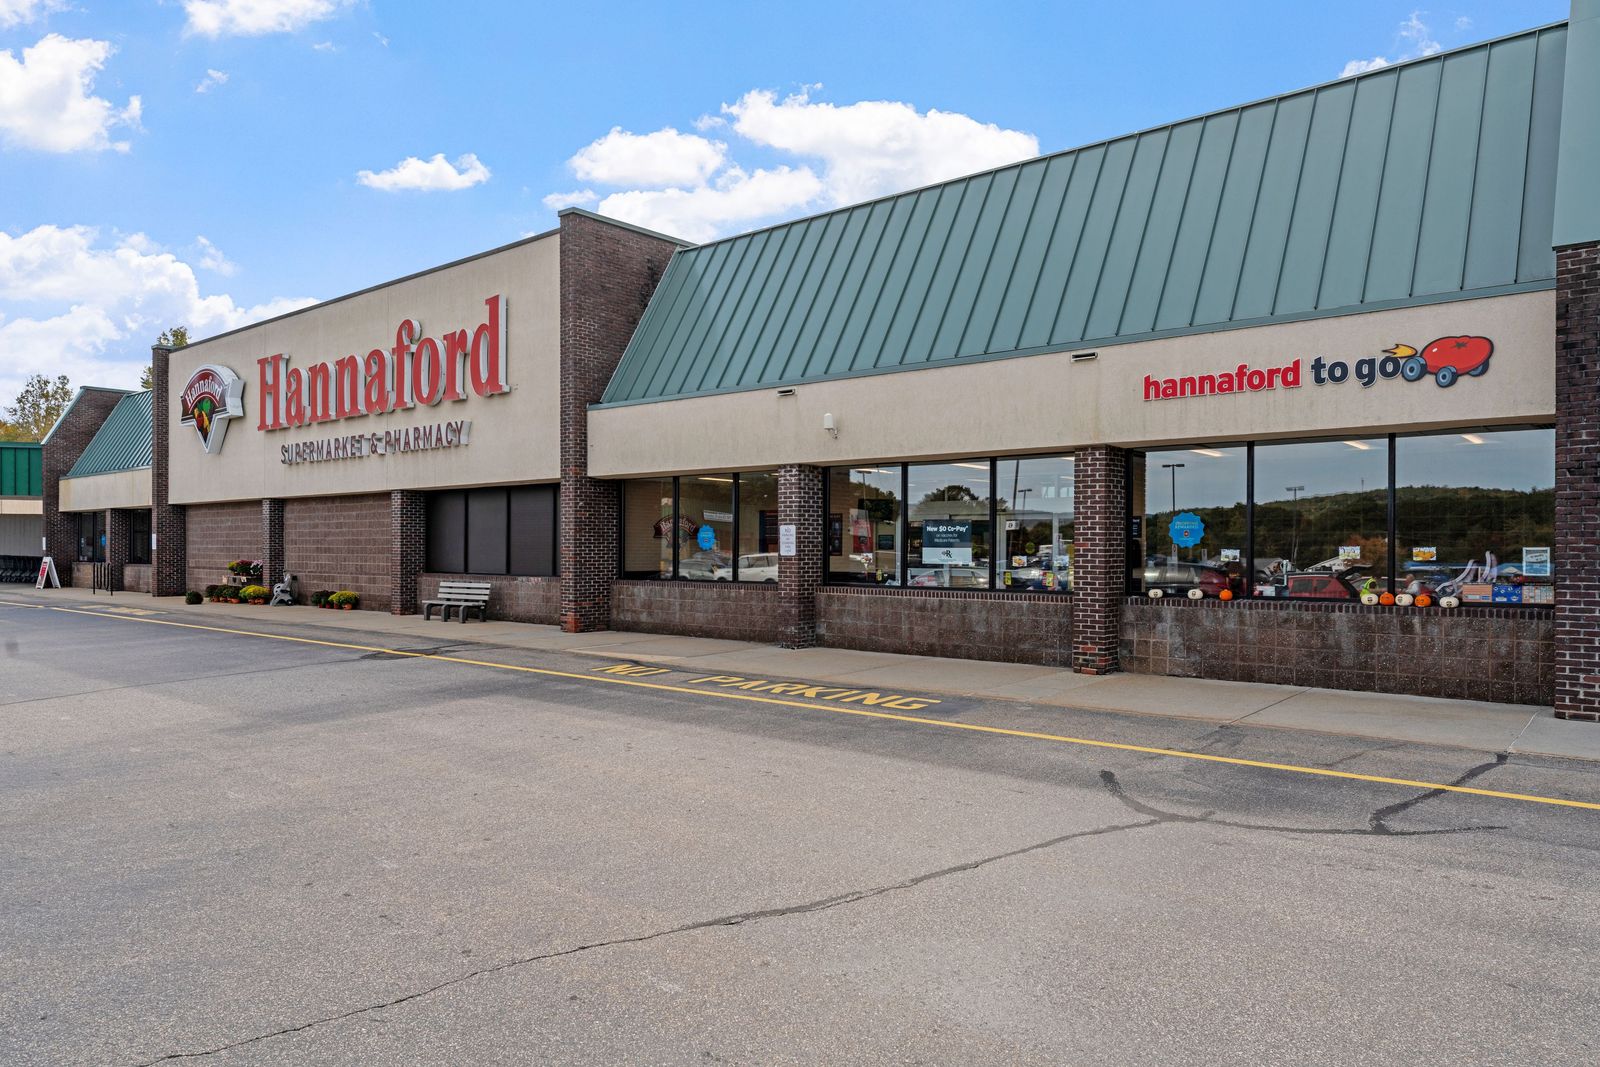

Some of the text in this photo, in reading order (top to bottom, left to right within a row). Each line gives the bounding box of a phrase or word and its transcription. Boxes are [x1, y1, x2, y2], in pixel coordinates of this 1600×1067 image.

[257, 294, 509, 431] Hannaford
[1143, 355, 1401, 401] hannaford to go
[185, 376, 223, 408] Hannaford
[281, 420, 468, 464] SUPERMARKET & PHARMACY
[592, 663, 942, 710] NO PARKING
